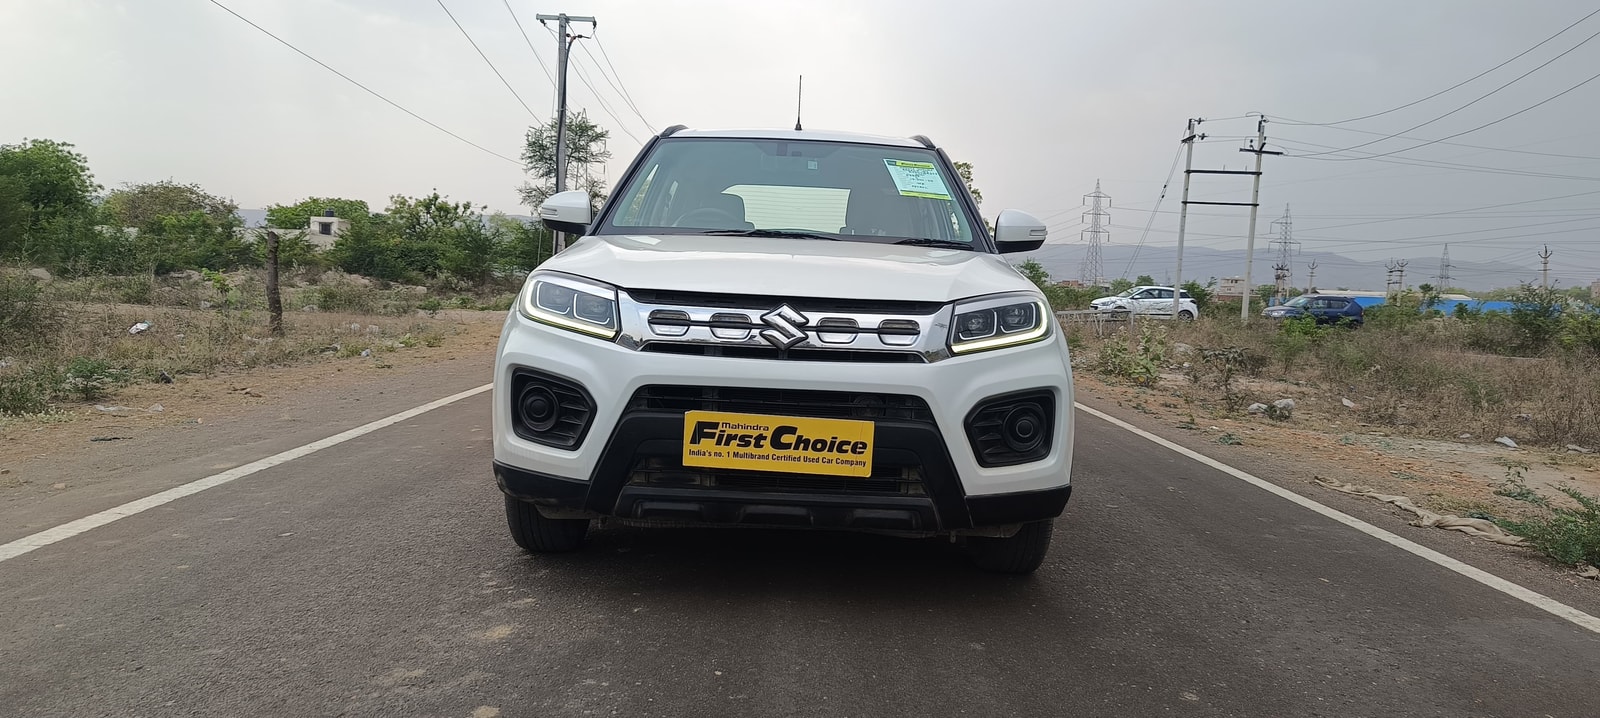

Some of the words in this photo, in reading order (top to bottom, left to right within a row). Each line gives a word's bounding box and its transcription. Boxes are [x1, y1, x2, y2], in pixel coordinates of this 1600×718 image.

[721, 422, 769, 432] Mahindra
[690, 421, 768, 449] First
[770, 425, 868, 455] Choice
[689, 449, 712, 457] India's
[733, 451, 770, 460] Multibrand
[772, 453, 801, 462] Certified
[803, 455, 820, 464] Used
[836, 457, 867, 468] Company
